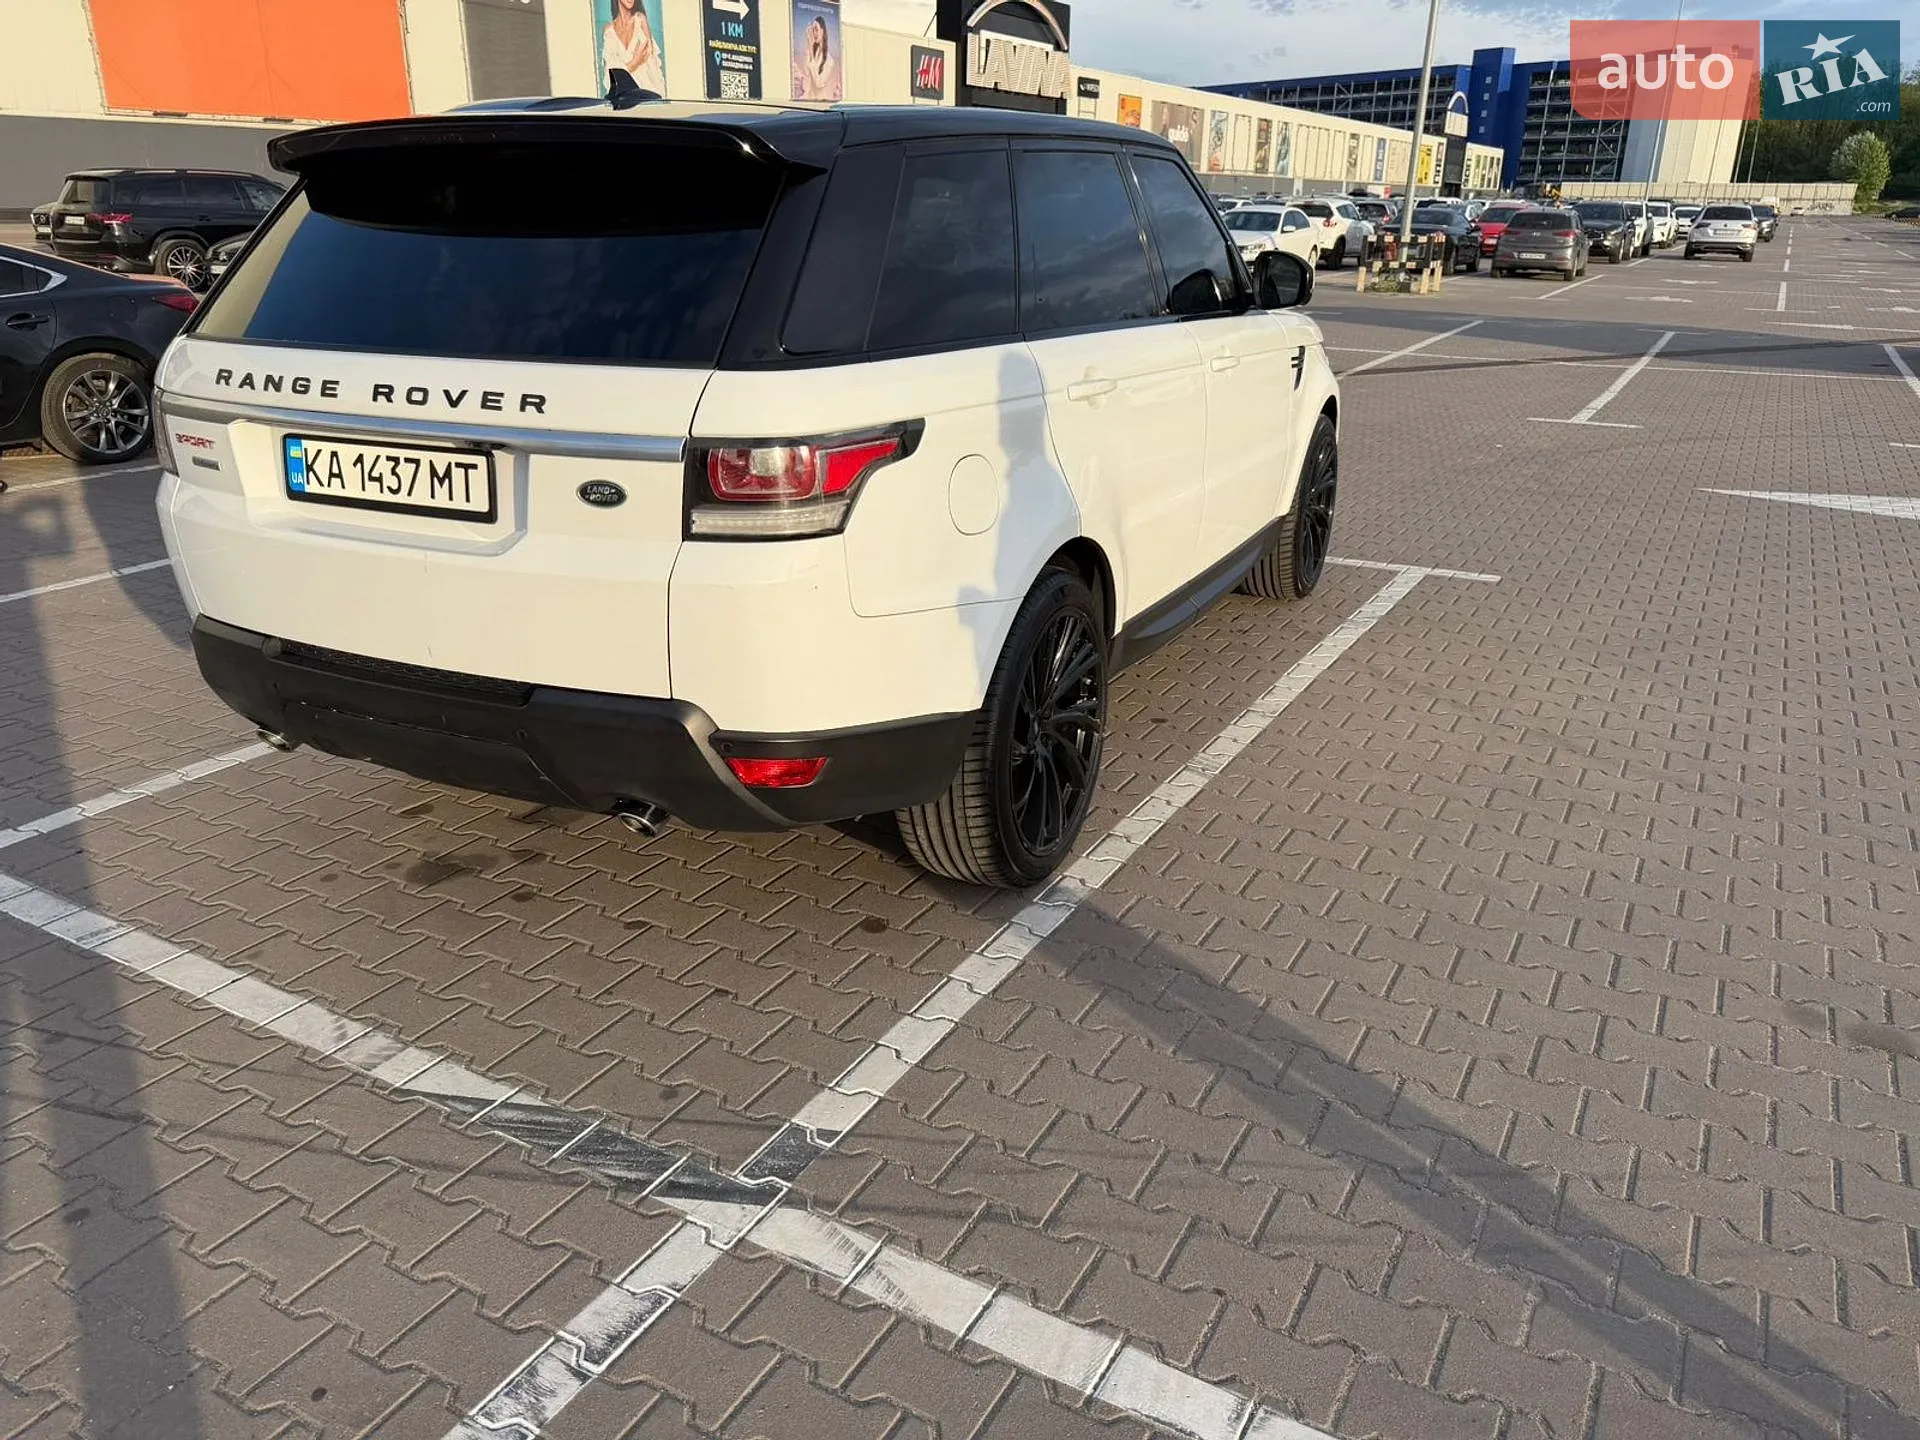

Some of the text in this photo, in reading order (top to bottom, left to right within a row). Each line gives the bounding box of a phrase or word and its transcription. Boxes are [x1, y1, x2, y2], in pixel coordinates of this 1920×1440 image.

[721, 22, 726, 35] 1
[966, 30, 1070, 99] LAVINA
[215, 368, 548, 414] RANGE ROVER
[291, 472, 303, 484] UA
[304, 448, 478, 503] KA 1437 MT
[590, 494, 618, 502] ROVER
